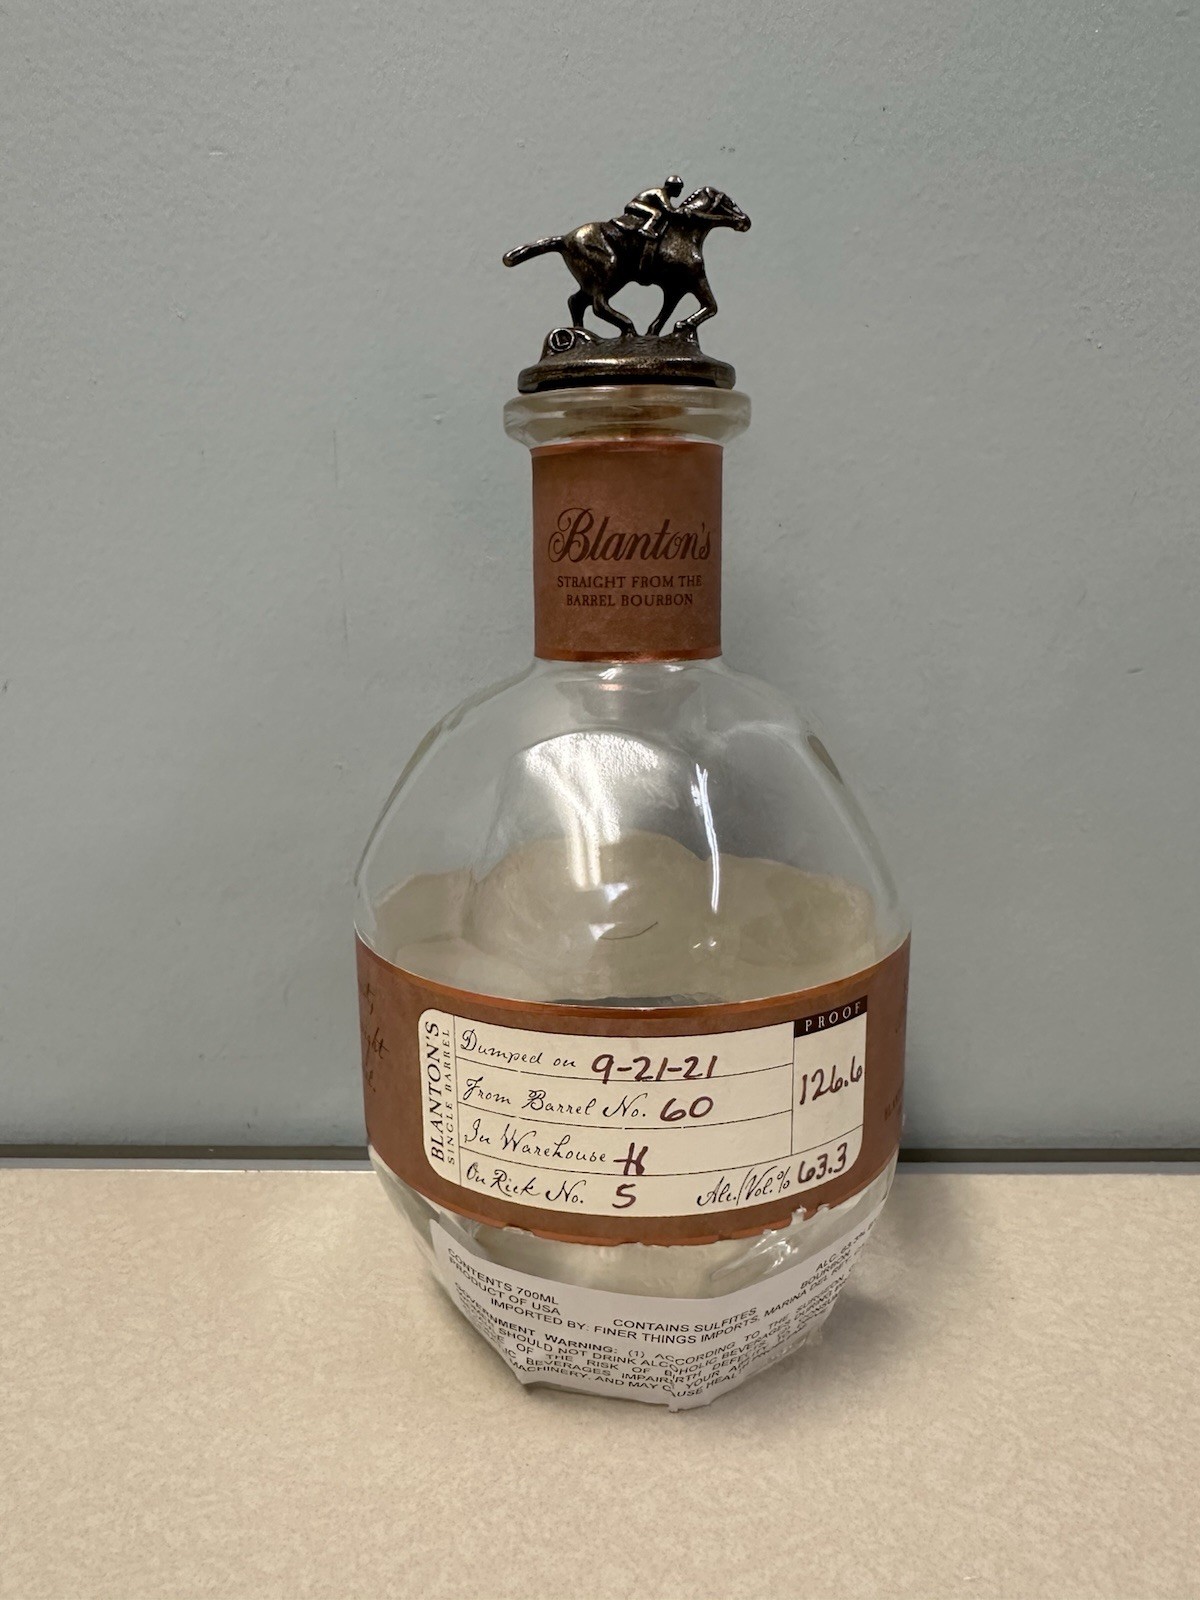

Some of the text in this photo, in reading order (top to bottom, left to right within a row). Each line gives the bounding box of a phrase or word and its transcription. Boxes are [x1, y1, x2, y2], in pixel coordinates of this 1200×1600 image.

[548, 507, 711, 563] Blanton's
[557, 575, 702, 588] STRAIGHT FROM THE
[566, 593, 693, 607] BARREL BOURBON
[805, 1001, 861, 1032] PROOF
[460, 1029, 576, 1068] Dumped on
[591, 1054, 718, 1084] 9-21-21
[425, 1021, 445, 1162] BLANTON'S
[442, 1029, 455, 1165] SINGLE BARREL
[463, 1076, 648, 1118] From Barrel No.
[799, 1056, 863, 1105] 126.6
[659, 1096, 714, 1122] 60
[464, 1118, 607, 1163] In Warehouse
[613, 1142, 649, 1176] H
[466, 1162, 587, 1204] On Rick No.
[797, 1142, 848, 1184] 63.3
[612, 1184, 637, 1209] 5
[447, 1248, 559, 1305] CONTENTS 700ML
[449, 1257, 561, 1316] PRODUCT OF USA
[455, 1281, 536, 1337] GOVERNMENT
[544, 1333, 618, 1354] WARNING:
[628, 1350, 645, 1358] (1)
[655, 1341, 736, 1366] ACCORDING
[744, 1331, 760, 1342] TO
[769, 1313, 789, 1329] THE
[490, 1298, 563, 1326] IMPORTED
[567, 1320, 590, 1332] BY:
[594, 1325, 637, 1340] FINER
[642, 1333, 696, 1344] THINGS
[763, 1290, 807, 1317] MARINA
[613, 1307, 757, 1332] CONTAINS SULFITES
[498, 1327, 553, 1352] SHOULD
[558, 1347, 587, 1357] NOT
[592, 1352, 637, 1365] DRINK
[640, 1356, 717, 1376] ALCOHOLIC
[721, 1319, 791, 1361] BEVERAGES
[516, 1343, 534, 1355] OF
[545, 1354, 574, 1363] THE
[586, 1359, 619, 1371] RISK
[632, 1367, 651, 1375] OF
[526, 1357, 611, 1376] BEVERAGES
[685, 1371, 720, 1389] YOUR
[594, 1376, 625, 1386] AND
[628, 1381, 659, 1390] MAY
